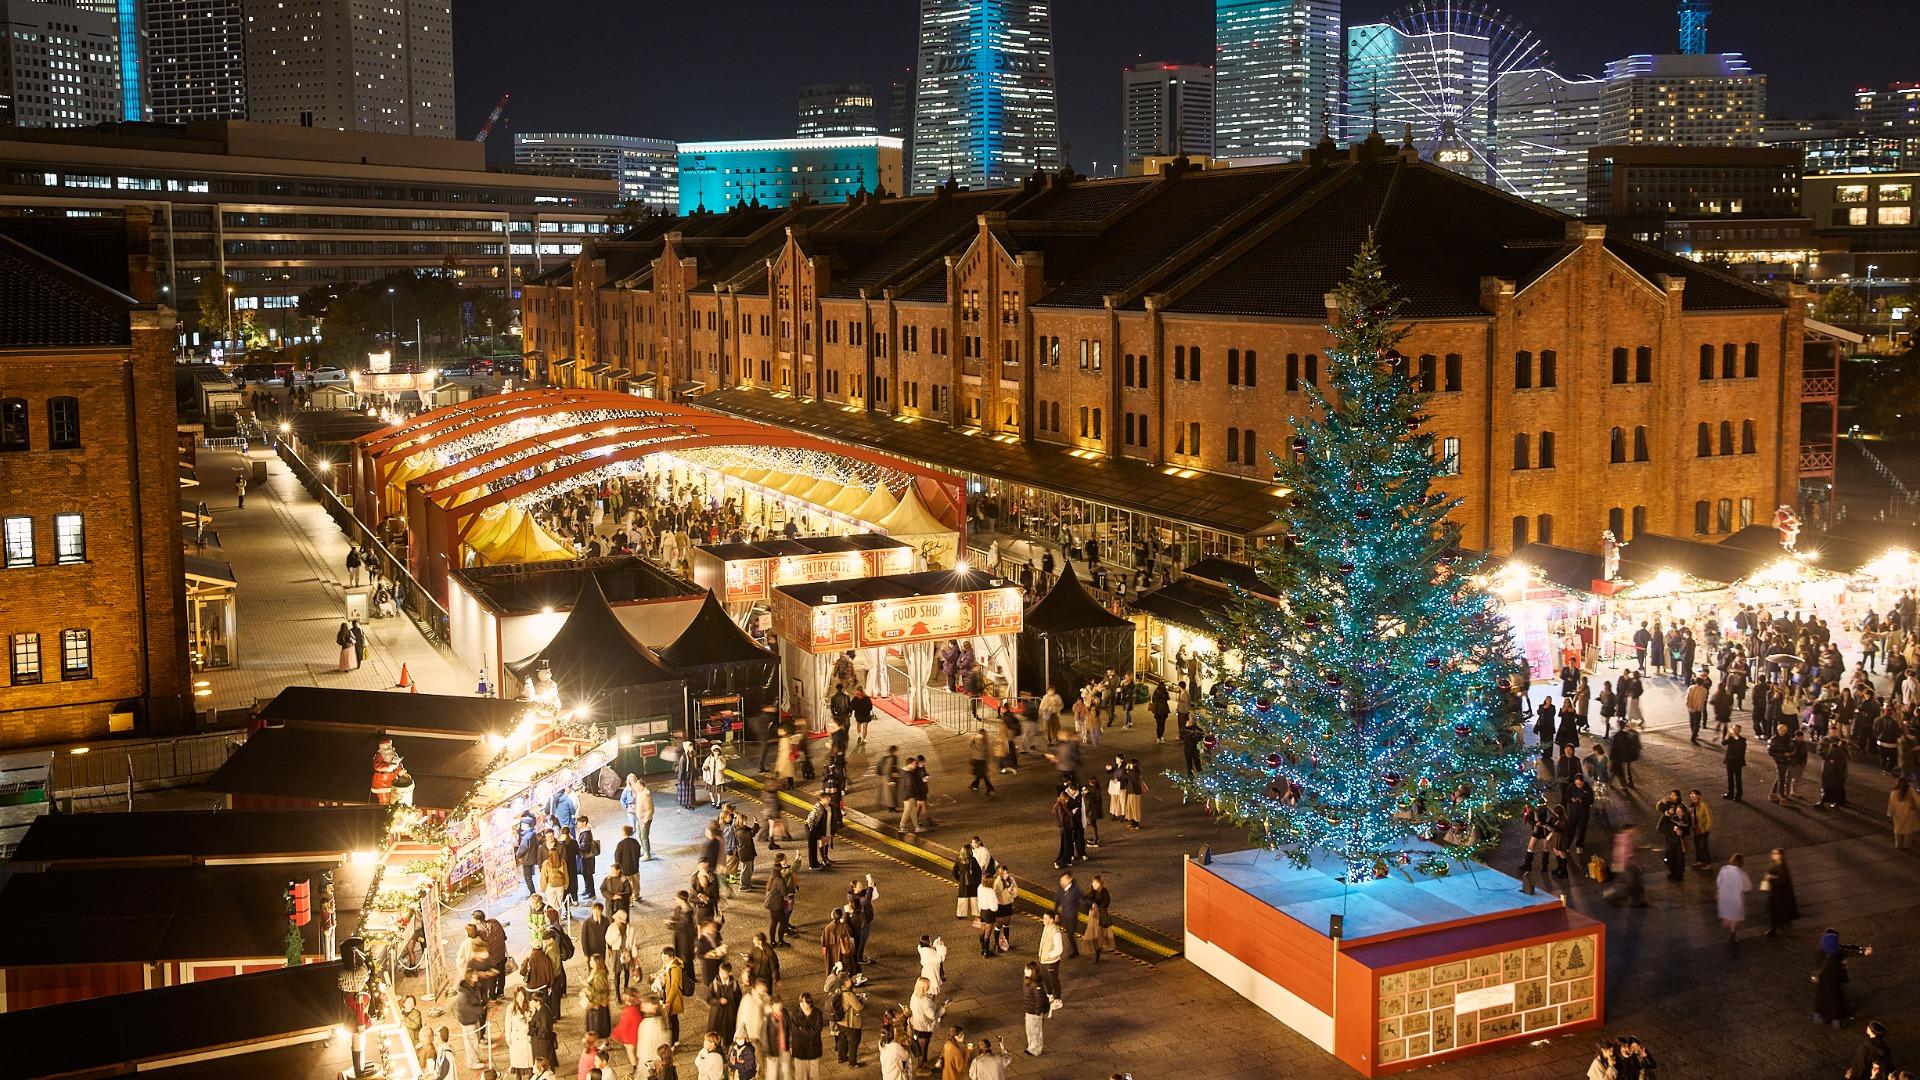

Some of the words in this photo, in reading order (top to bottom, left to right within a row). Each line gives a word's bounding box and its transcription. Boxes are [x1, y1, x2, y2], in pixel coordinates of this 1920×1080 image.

[1439, 151, 1469, 162] 20:15
[893, 606, 917, 622] FOOD
[920, 604, 944, 618] SHOP
[1556, 949, 1567, 959] 25
